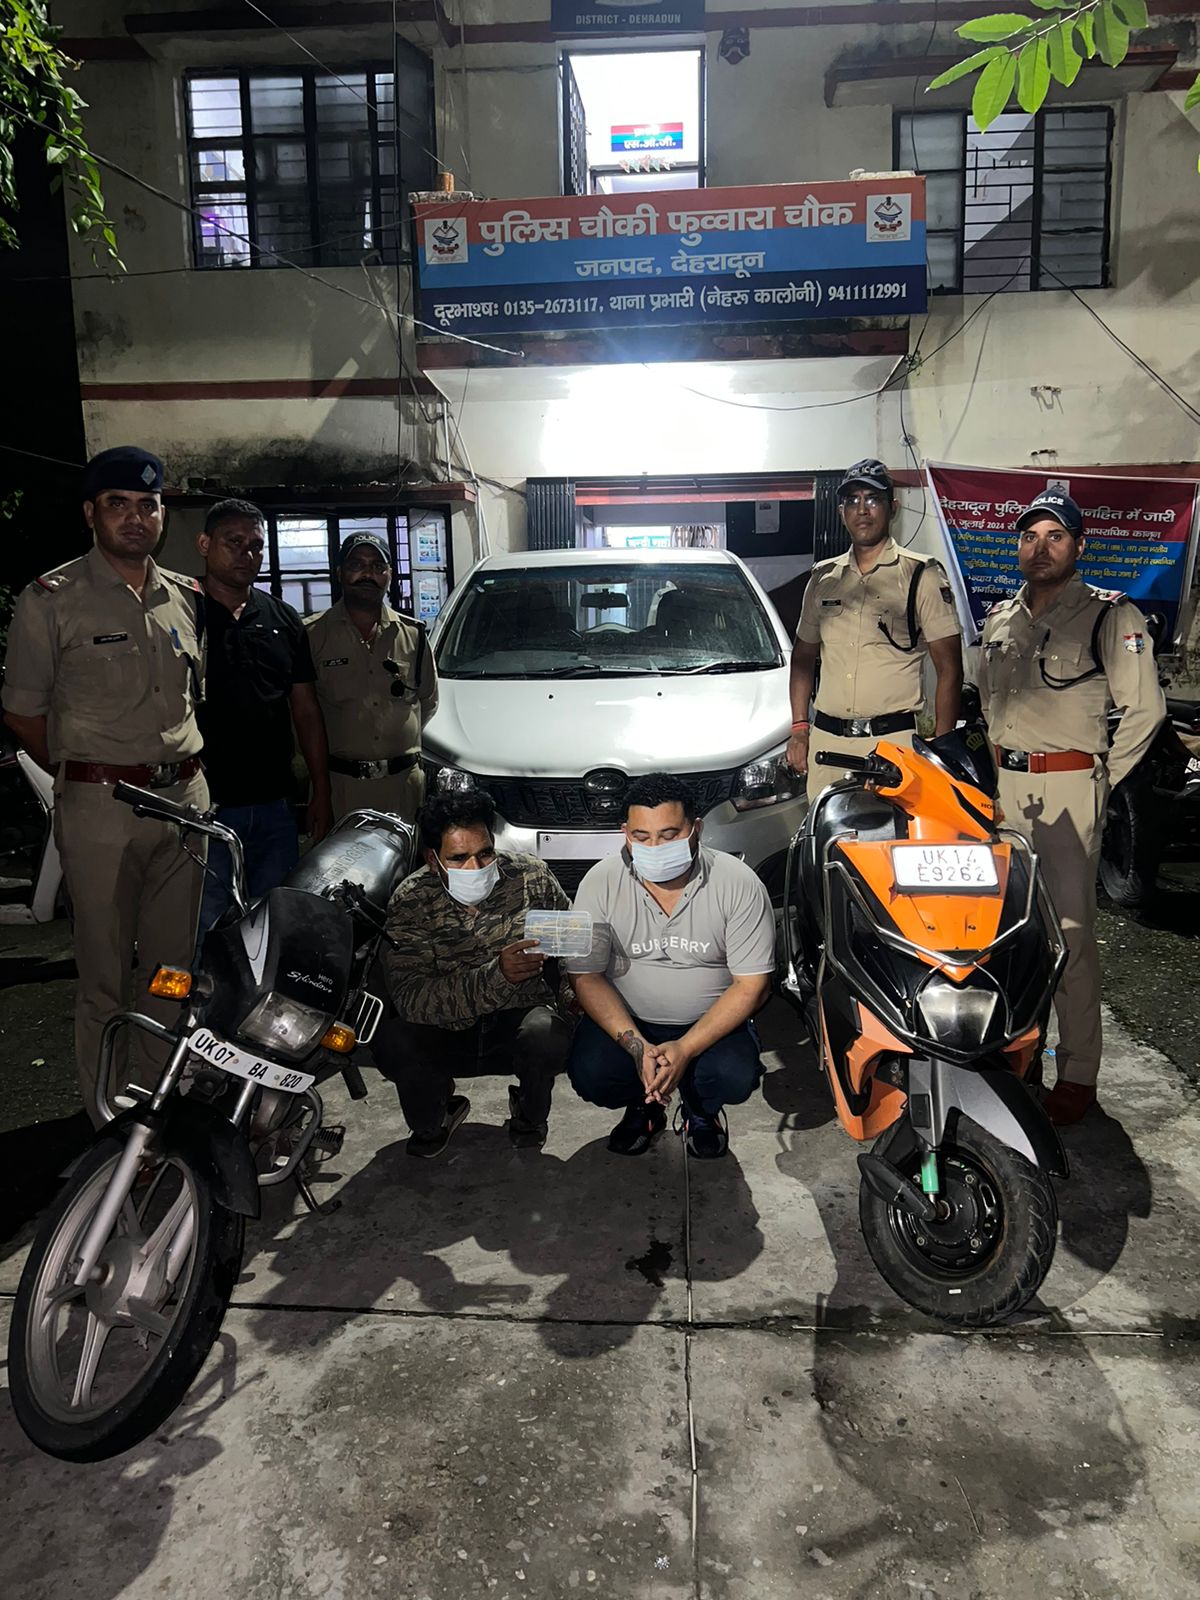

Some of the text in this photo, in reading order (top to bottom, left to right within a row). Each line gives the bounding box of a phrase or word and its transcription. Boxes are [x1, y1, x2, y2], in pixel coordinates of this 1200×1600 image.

[576, 15, 619, 25] DISTRICT
[629, 14, 681, 24] DEHRADUN
[478, 194, 857, 257] पुलिस चौकी फुव्वारा चौक
[574, 249, 766, 279] जनपद, देहरादून
[503, 296, 604, 316] 0135-2673117,
[609, 294, 646, 311] थाना
[649, 286, 695, 312] प्रभारी
[700, 284, 751, 312] (नेहरू
[753, 280, 822, 308] कालोनी)
[828, 282, 907, 302] 9411112991
[959, 518, 986, 530] जुलाई
[987, 521, 1004, 530] 2024
[1080, 506, 1124, 520] नहित
[1126, 507, 1142, 521] में
[1143, 508, 1176, 522] जारी
[631, 936, 711, 954] BURBERRY
[247, 1062, 269, 1080] BA
[279, 1073, 303, 1089] 820
